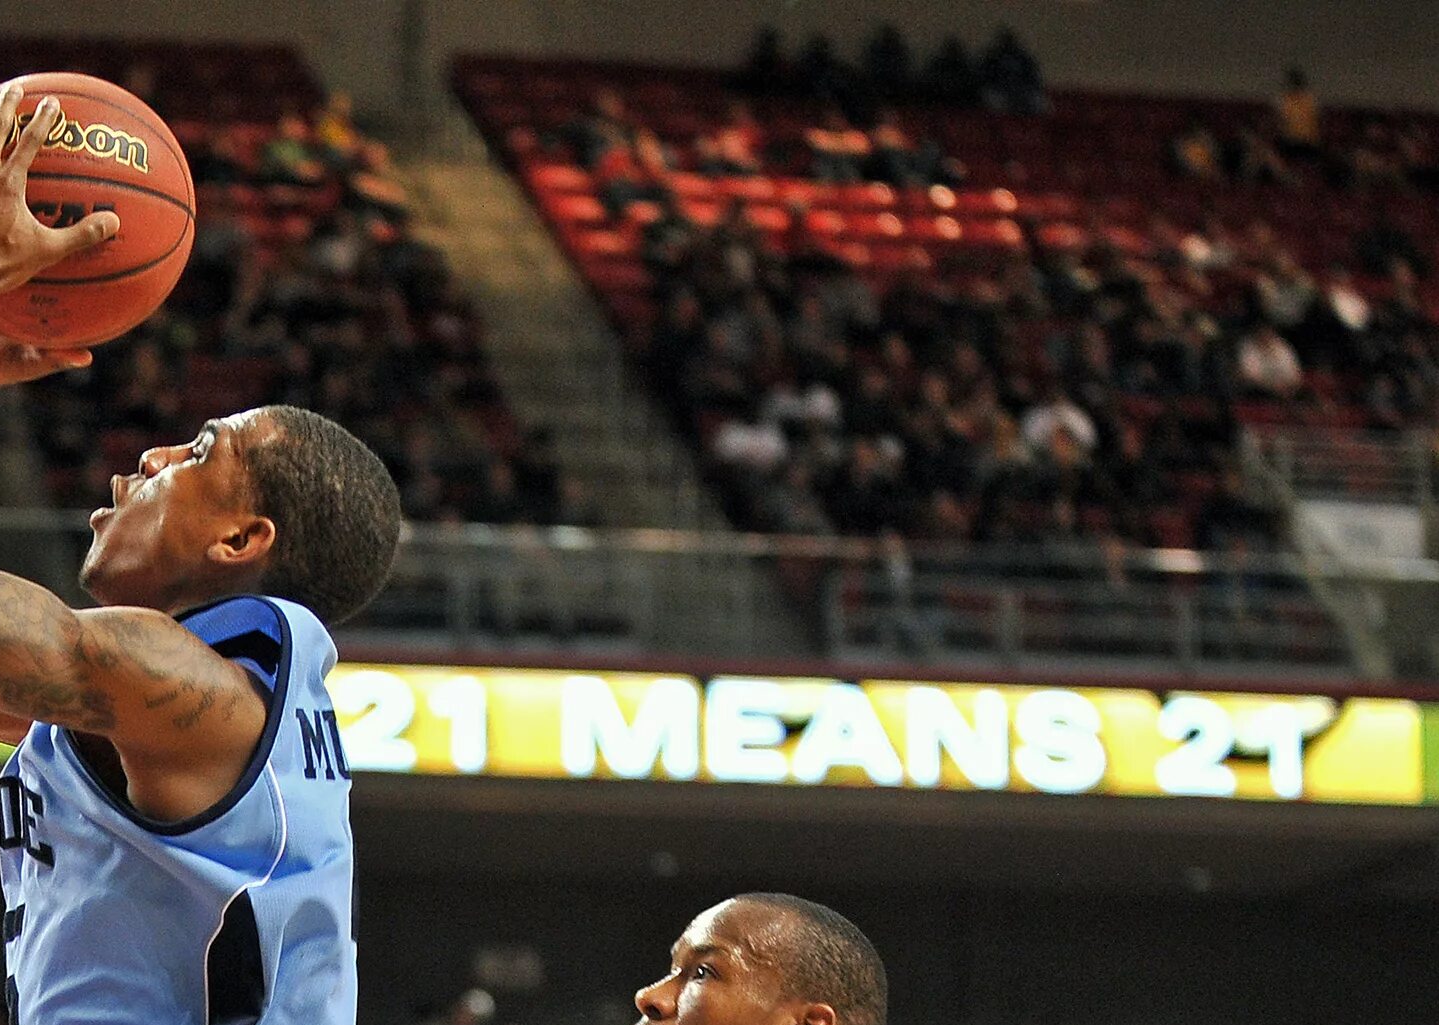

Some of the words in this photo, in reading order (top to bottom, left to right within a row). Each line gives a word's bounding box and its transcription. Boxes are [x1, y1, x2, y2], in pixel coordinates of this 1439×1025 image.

[17, 108, 148, 174] lson
[334, 671, 488, 775] 21
[561, 676, 1107, 795] MEANS
